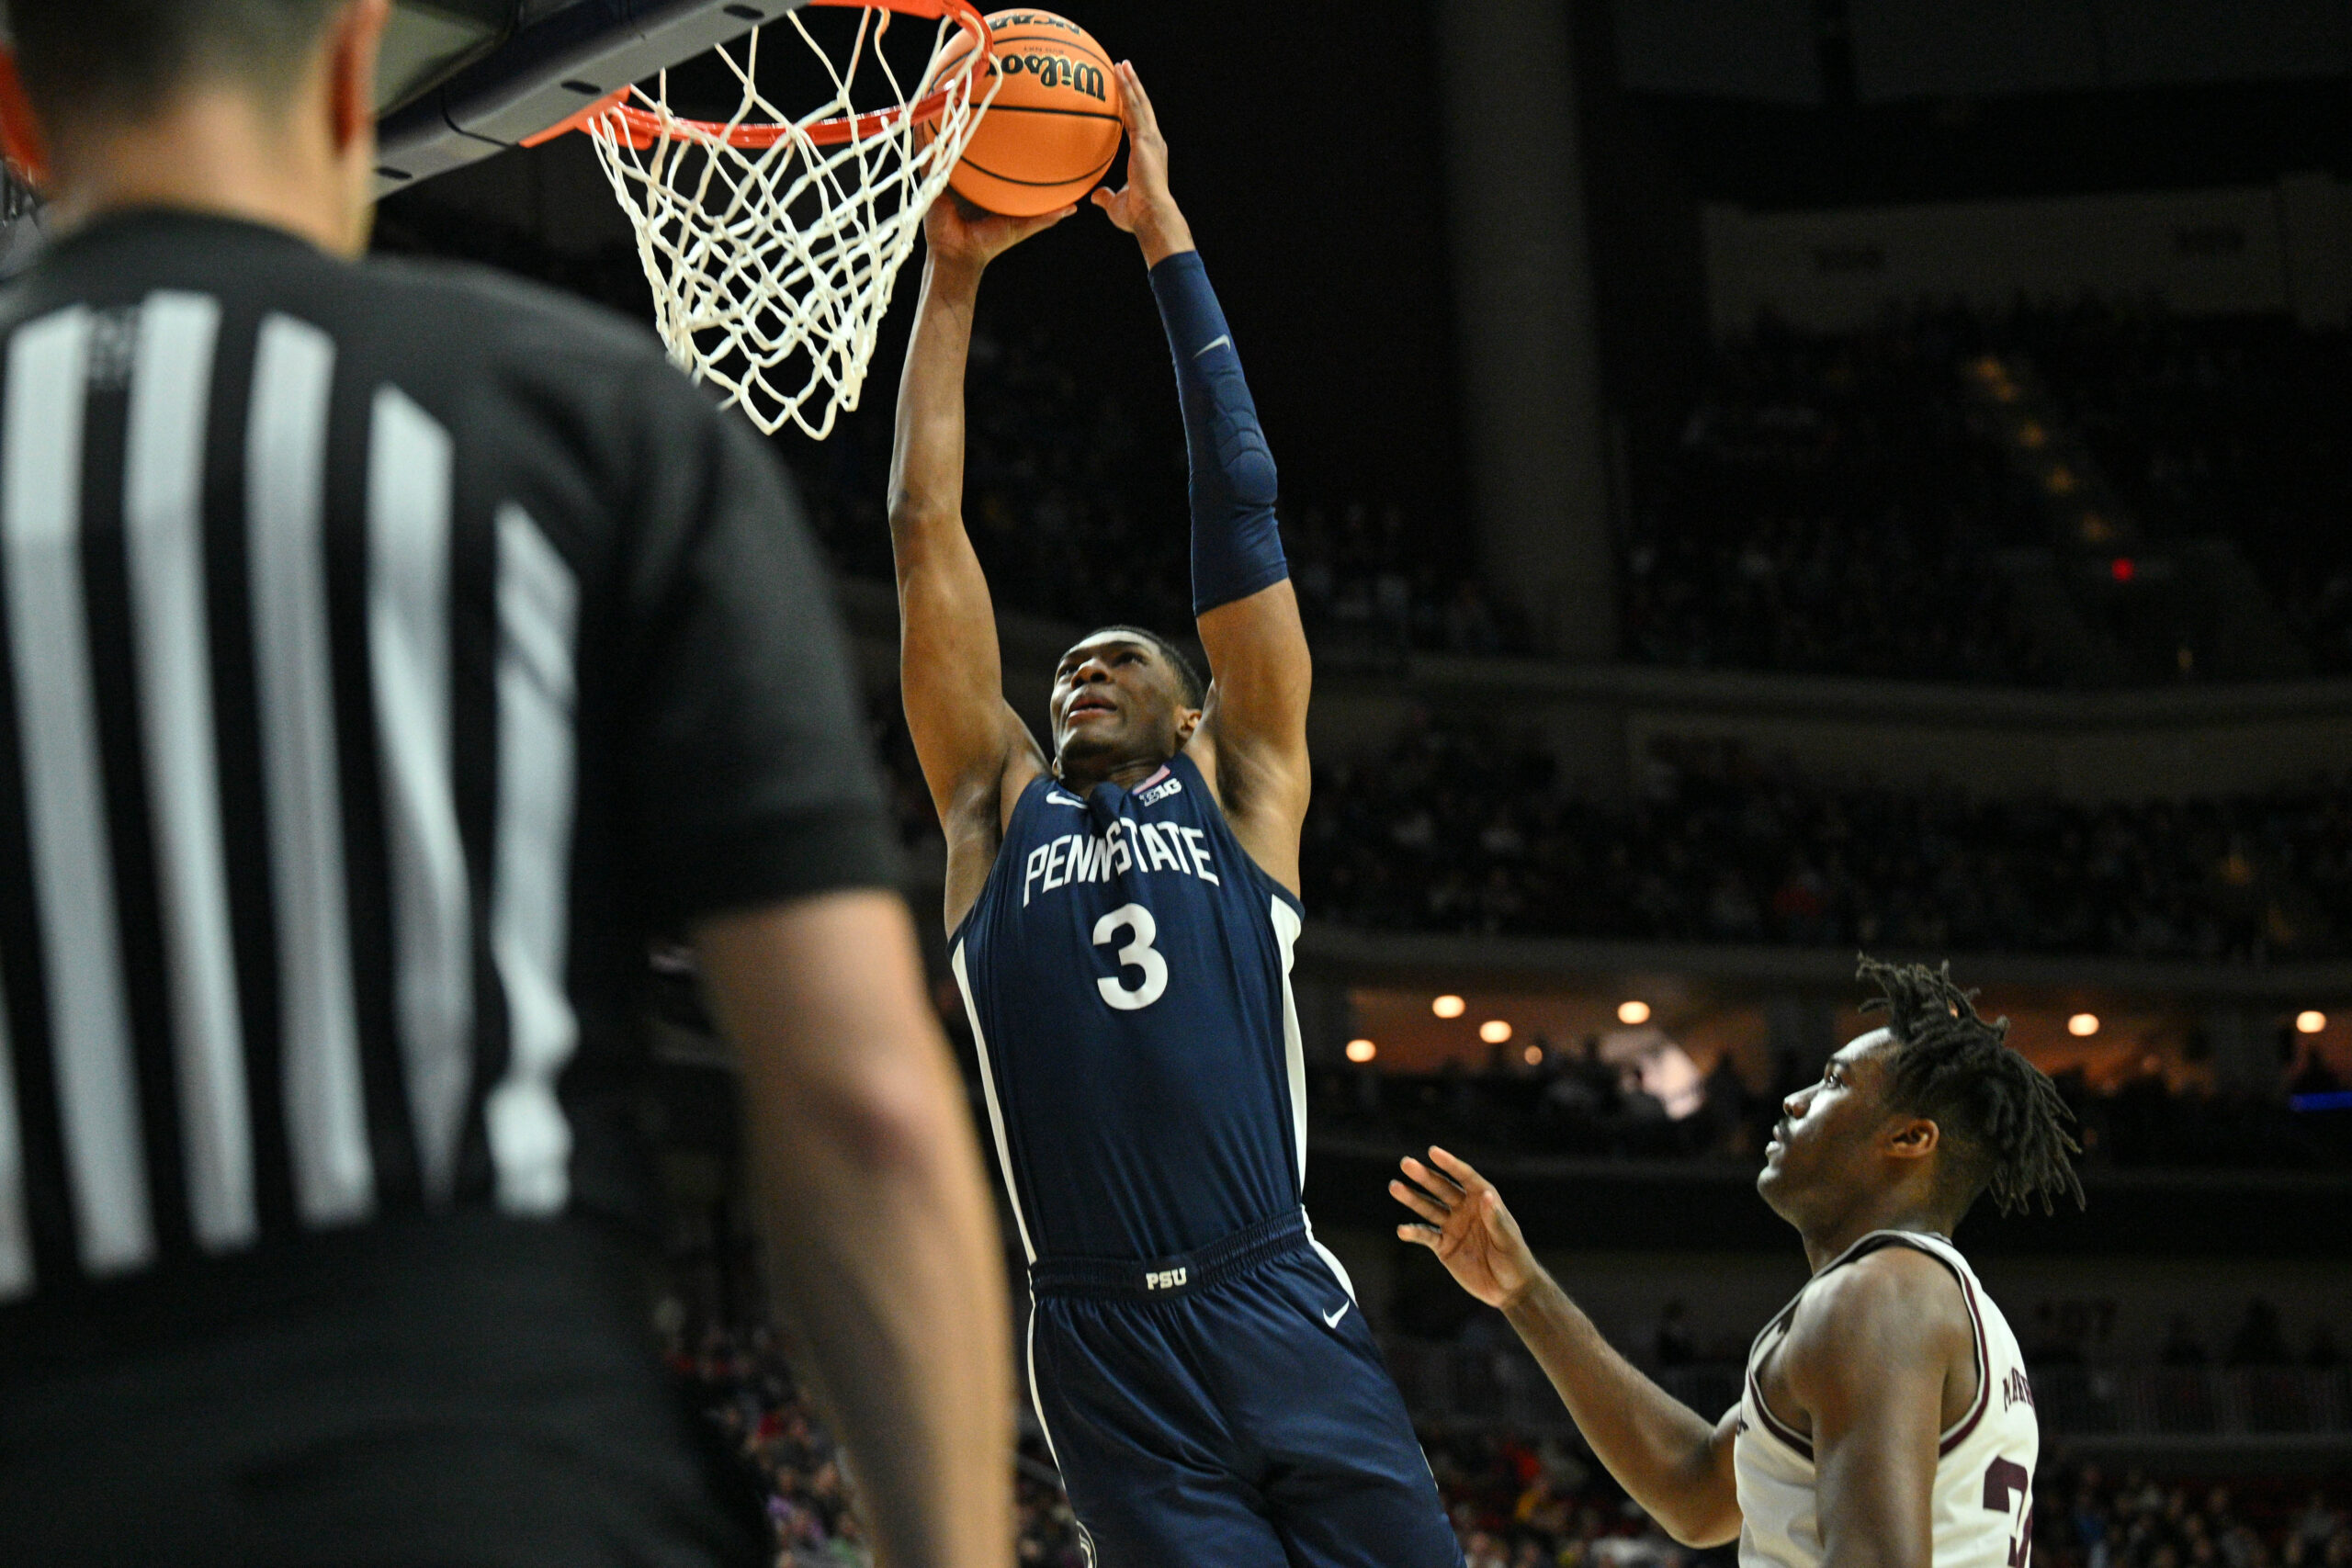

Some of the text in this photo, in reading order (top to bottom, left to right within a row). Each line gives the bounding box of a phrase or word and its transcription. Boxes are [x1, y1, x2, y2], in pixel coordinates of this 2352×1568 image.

[1023, 817, 1220, 908] PENN STATE
[1092, 902, 1169, 1010] 3
[1146, 1267, 1187, 1291] PSU
